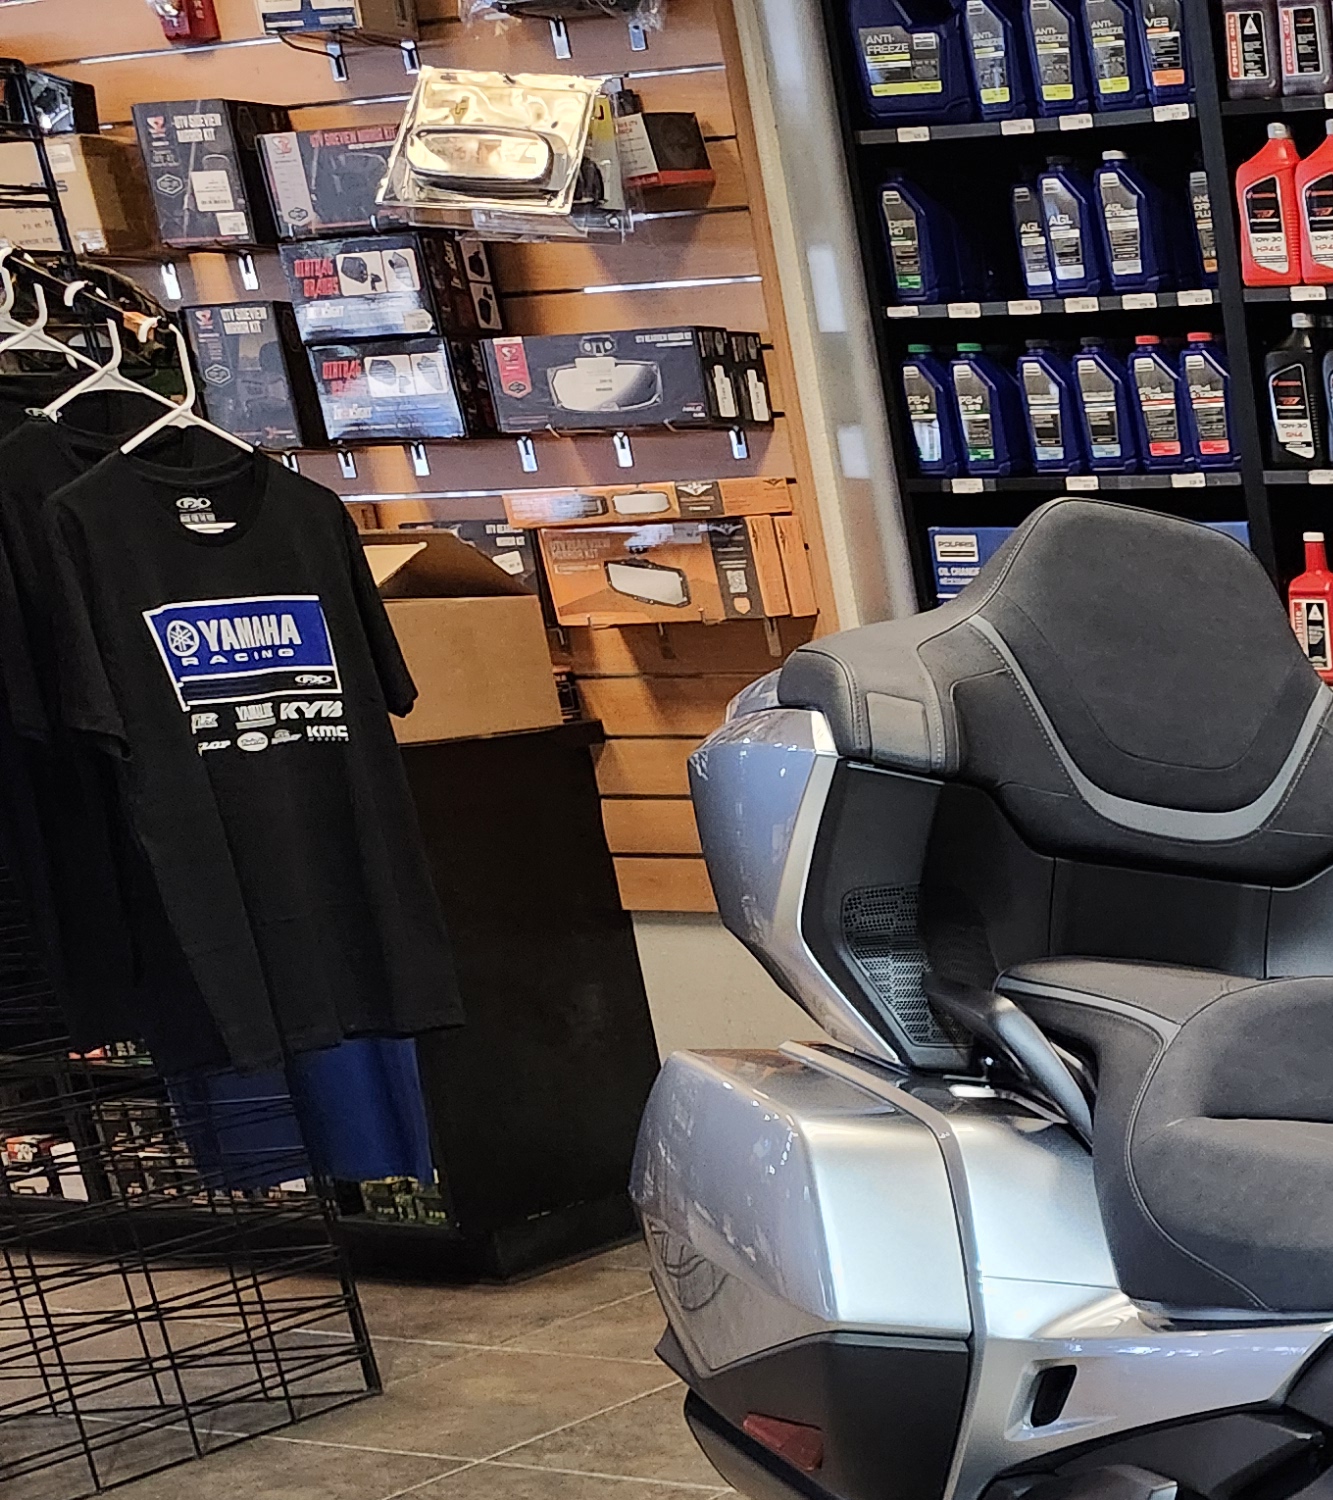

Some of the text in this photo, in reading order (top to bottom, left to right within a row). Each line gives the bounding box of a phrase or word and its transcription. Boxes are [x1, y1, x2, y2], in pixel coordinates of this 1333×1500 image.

[1091, 20, 1114, 29] ANTI-
[973, 31, 994, 40] ANTI-
[1035, 27, 1058, 36] ANTI-
[1092, 26, 1124, 36] FREEZE
[866, 34, 895, 45] ANTI-
[974, 37, 1005, 47] FREEZE
[1036, 34, 1069, 43] FREEZE
[1282, 11, 1294, 74] FORK OIL
[867, 43, 909, 54] FREEZE
[1228, 14, 1239, 76] FORK OIL
[1105, 203, 1124, 211] AGL
[1049, 215, 1073, 225] AGL
[1020, 223, 1042, 233] AGL
[938, 567, 951, 576] OIL
[197, 614, 302, 652] YAMAHA
[181, 648, 294, 667] RACING
[280, 700, 344, 720] KYB
[306, 725, 348, 738] KMC
